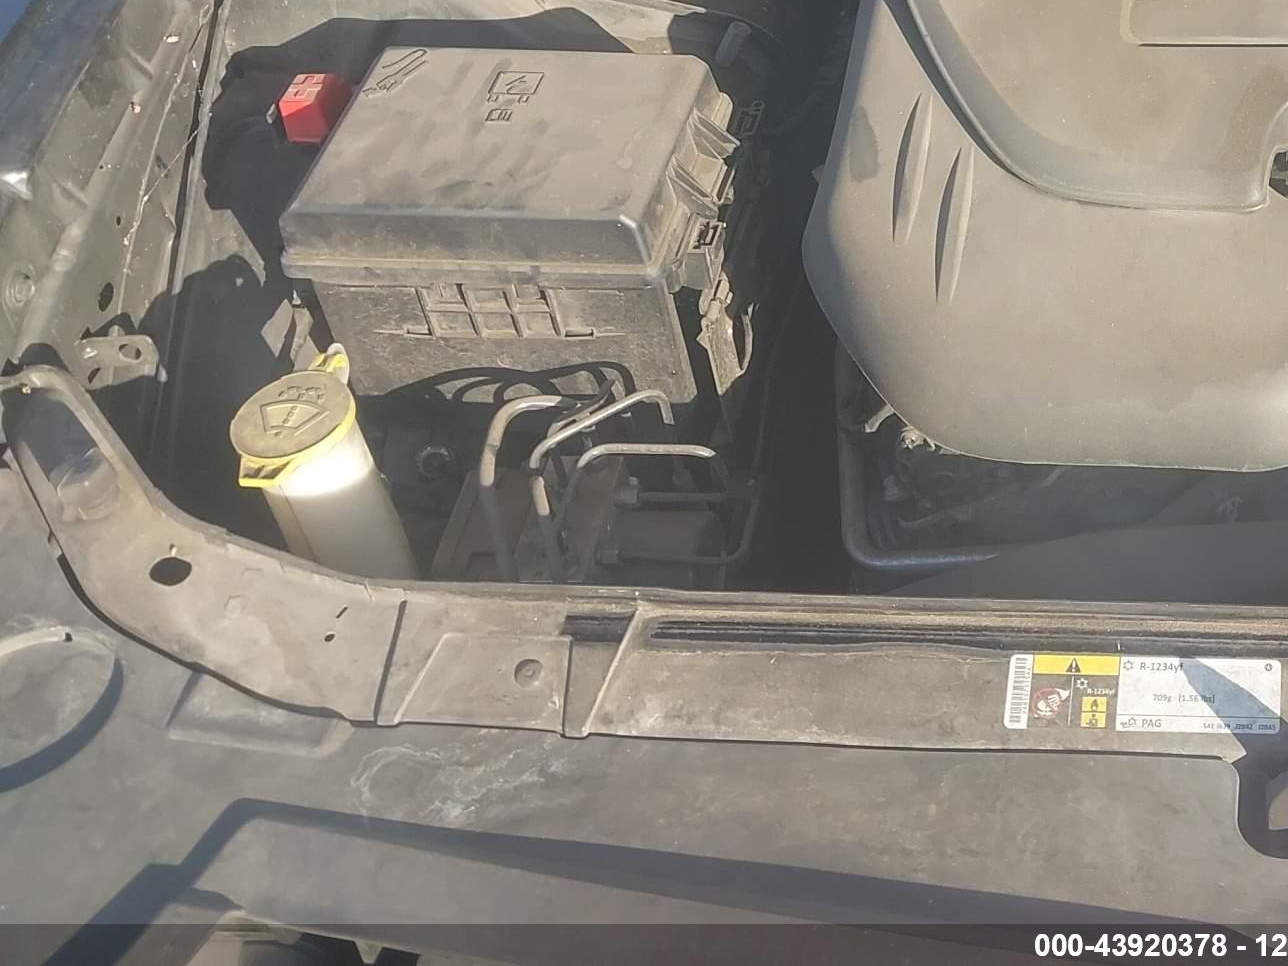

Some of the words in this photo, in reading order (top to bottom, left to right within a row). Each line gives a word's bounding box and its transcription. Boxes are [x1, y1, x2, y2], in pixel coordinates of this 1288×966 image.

[1139, 662, 1184, 674] R-1234yf
[1152, 693, 1172, 703] 709g
[1141, 718, 1162, 728] PAG
